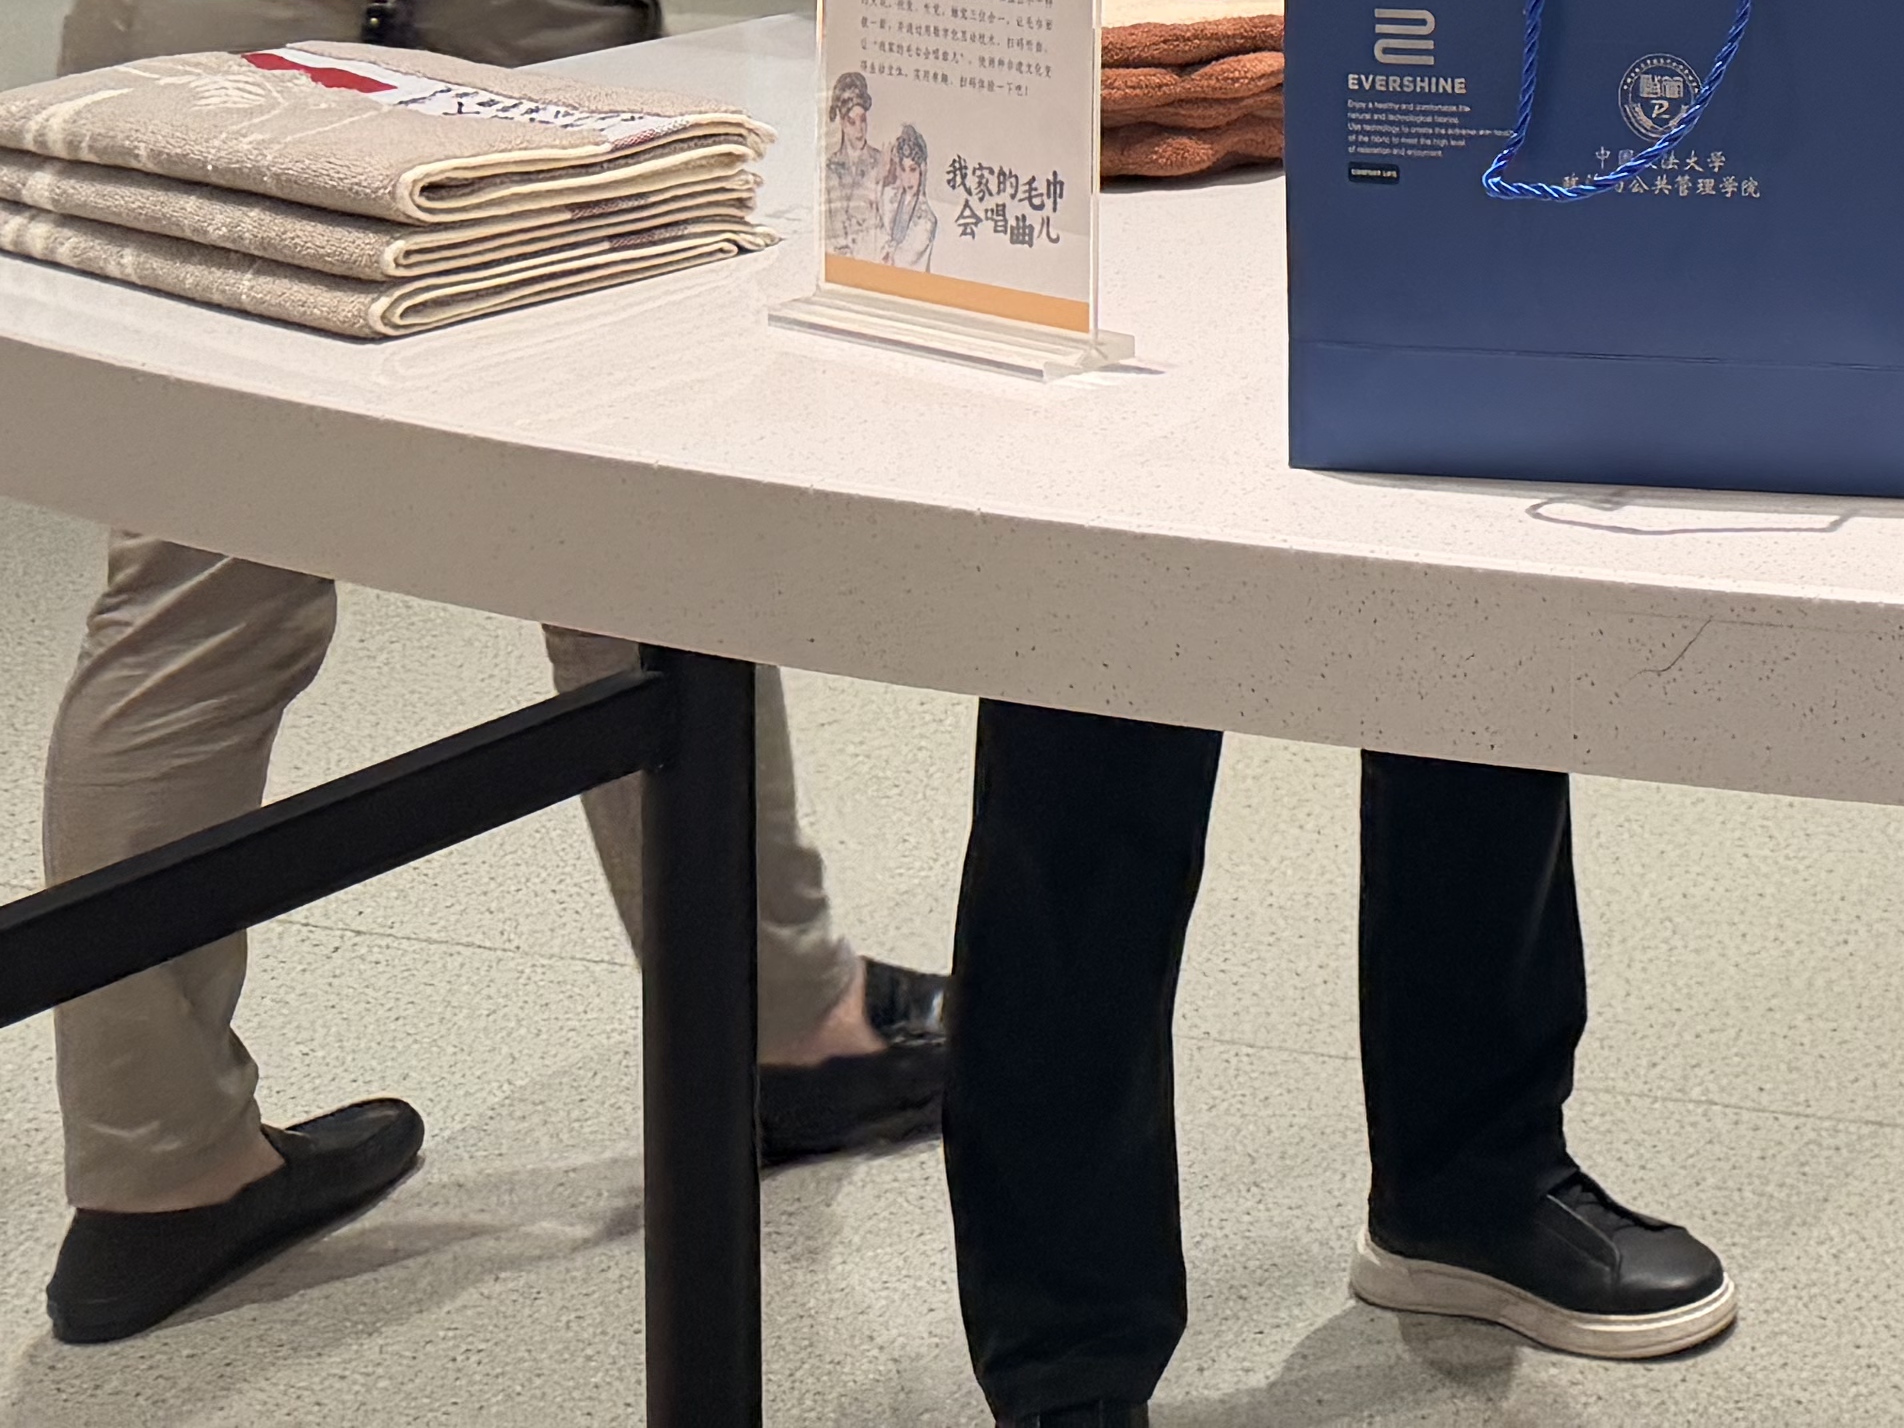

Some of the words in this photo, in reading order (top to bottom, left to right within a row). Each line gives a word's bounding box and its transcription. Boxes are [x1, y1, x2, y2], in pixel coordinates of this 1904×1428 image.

[1347, 73, 1467, 94] EVERSHINE
[1348, 100, 1366, 109] Enjoy
[1420, 137, 1431, 145] the
[1433, 137, 1448, 147] high
[1595, 146, 1727, 173] 中国法大学
[945, 153, 1065, 213] 我家的毛巾
[954, 197, 1061, 248] 会唱曲儿
